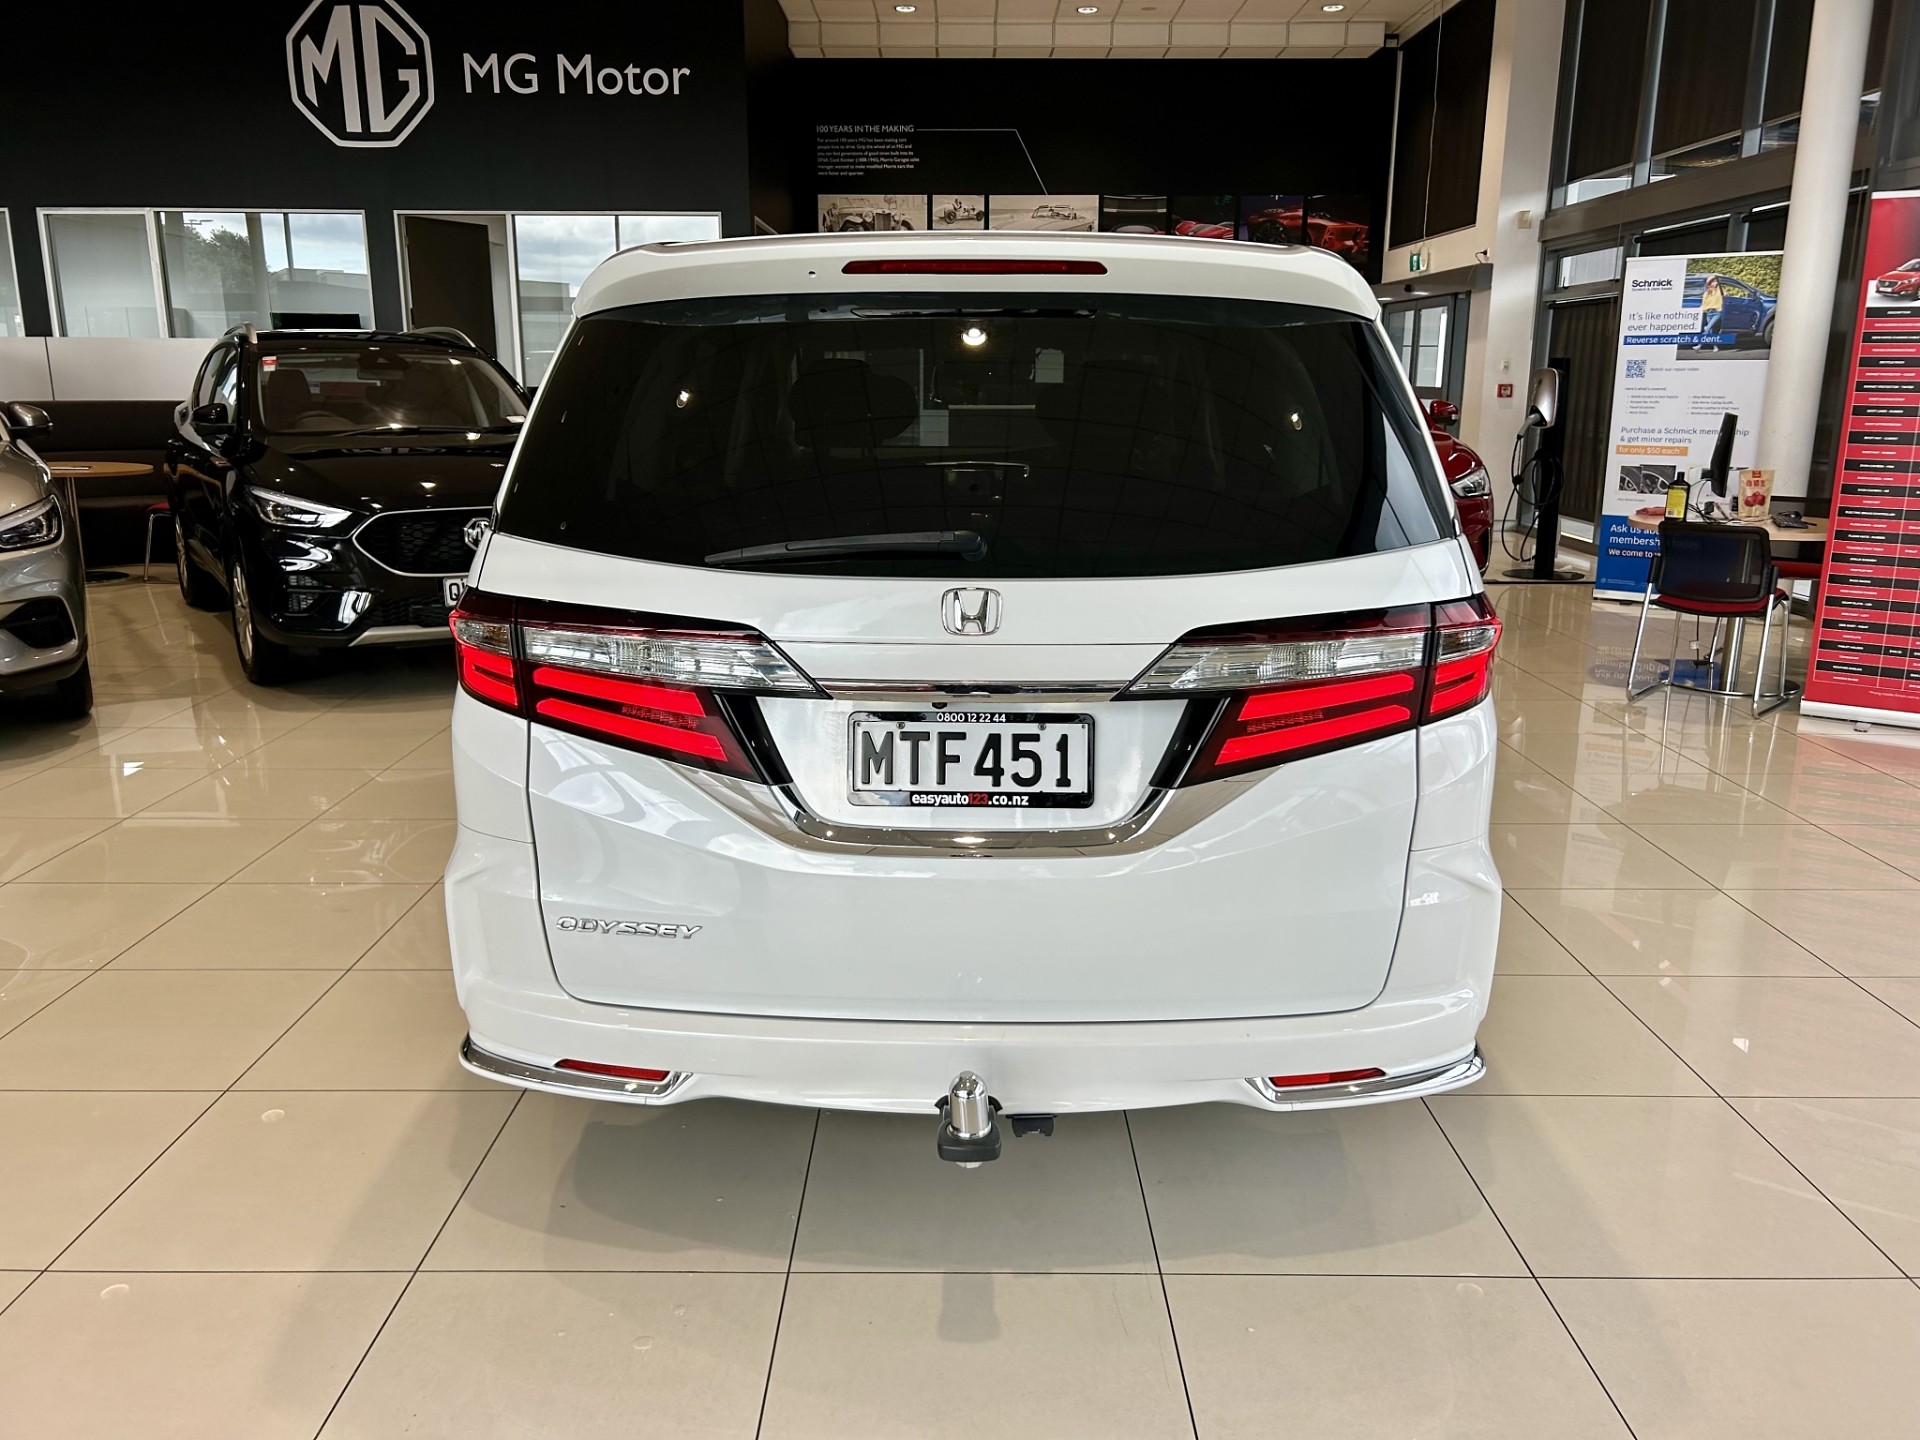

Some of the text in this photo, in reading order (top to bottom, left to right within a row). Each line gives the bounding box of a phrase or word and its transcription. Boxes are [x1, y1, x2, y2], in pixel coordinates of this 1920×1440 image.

[300, 5, 421, 133] MG
[463, 53, 691, 95] MG Motor
[816, 125, 915, 133] 100 YEARS IN THE MAKING
[1631, 279, 1673, 287] Schmick
[1645, 312, 1661, 321] like
[1663, 311, 1699, 321] nothing
[1649, 322, 1697, 332] happened.
[1660, 335, 1691, 343] scratch
[1700, 335, 1723, 343] dent.
[1621, 426, 1656, 434] Purchase
[1663, 427, 1698, 435] Schmick
[1630, 447, 1645, 455] only
[1610, 524, 1628, 533] Ask
[1629, 526, 1642, 534] us
[1608, 548, 1621, 556] We
[1621, 549, 1644, 557] come
[936, 712, 1007, 723] 0800 12 22 44
[861, 730, 1072, 788] MTF451
[911, 792, 1030, 807] easyauto123.co.nz
[556, 916, 703, 940] ODYSSEY
